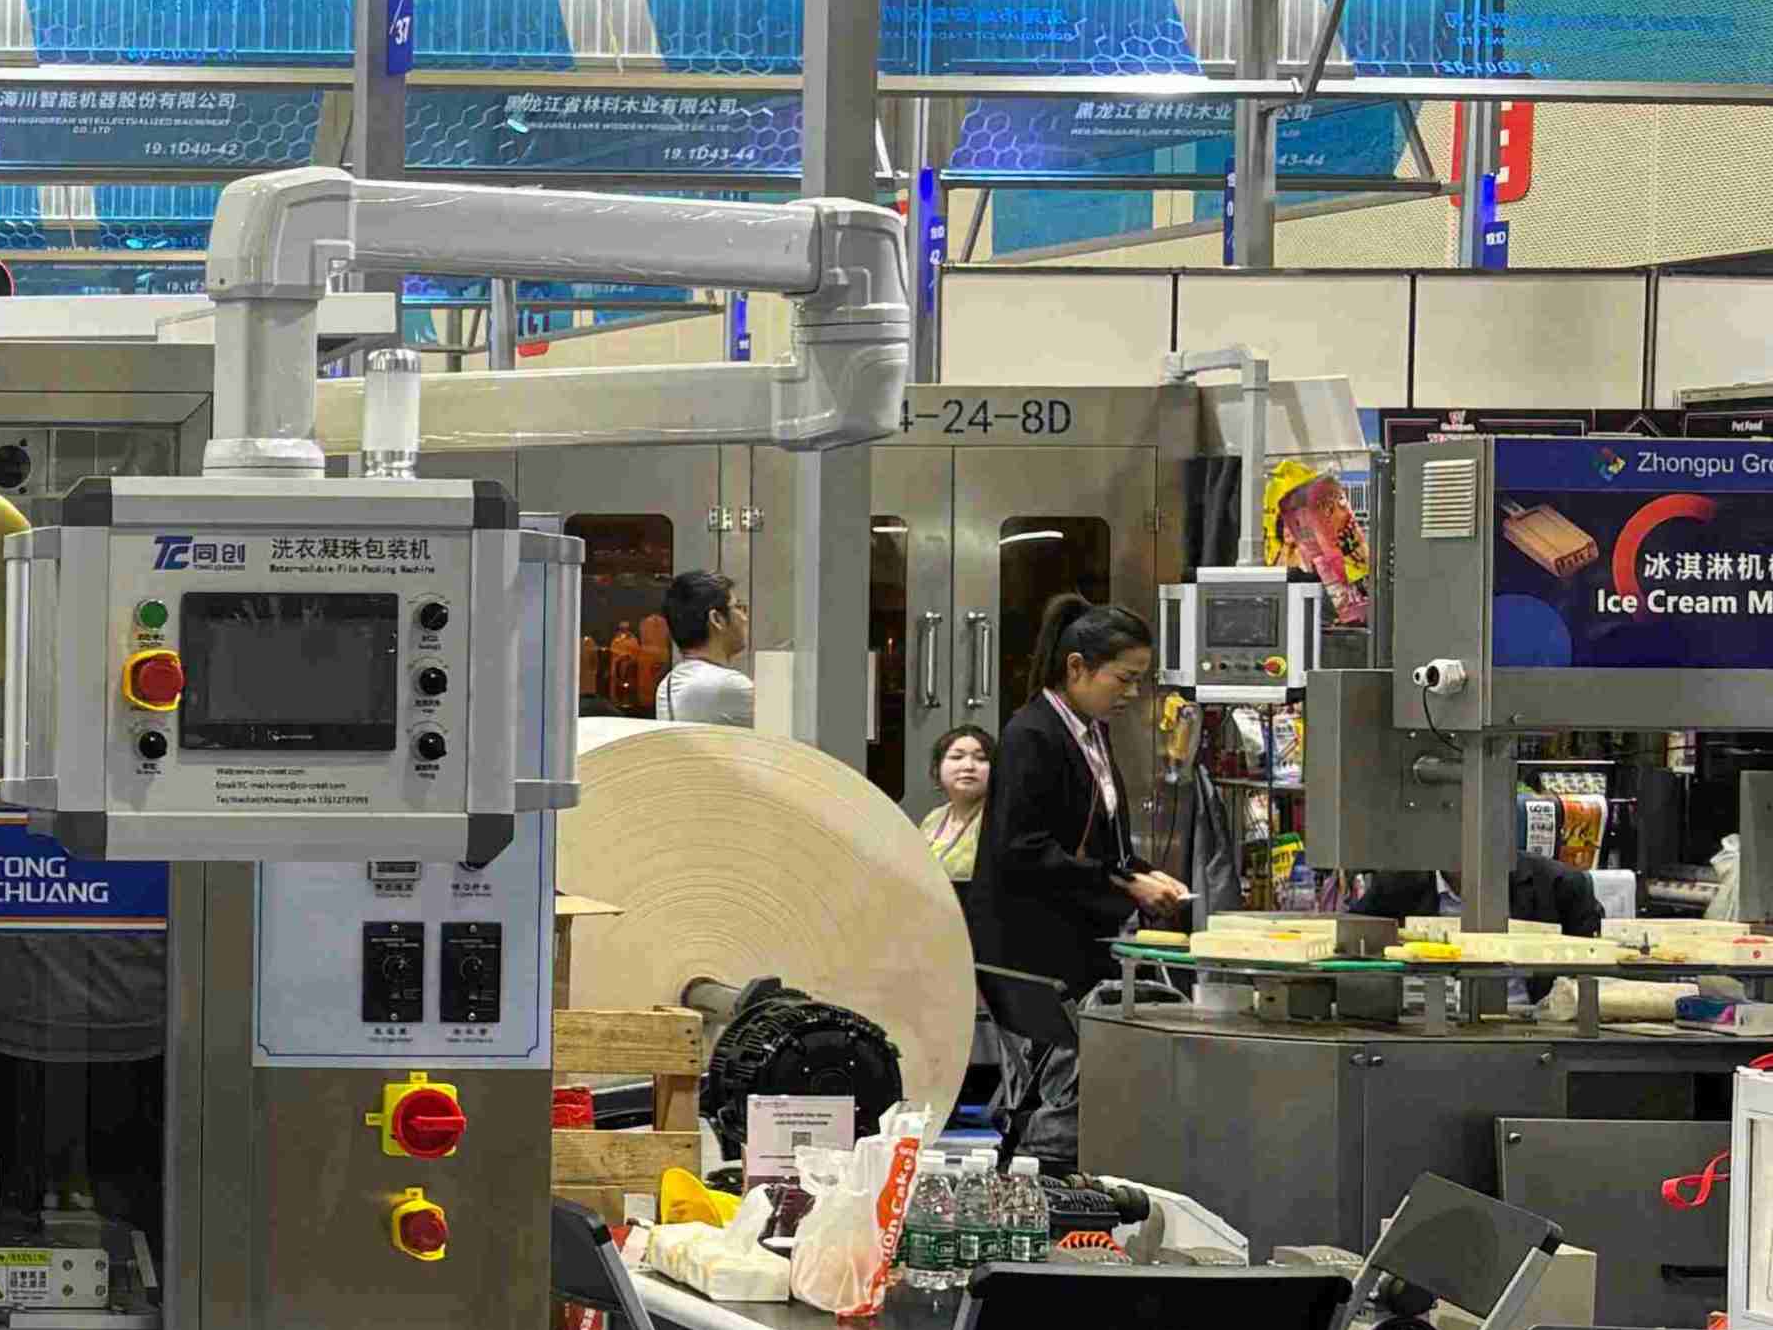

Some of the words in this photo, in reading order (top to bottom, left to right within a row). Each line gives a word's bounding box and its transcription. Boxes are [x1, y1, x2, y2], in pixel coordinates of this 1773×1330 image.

[394, 15, 411, 46] 37
[143, 141, 238, 157] 19.1D40-42
[662, 145, 755, 161] 19.1D43-44
[1636, 451, 1734, 478] Zhongpu
[193, 542, 246, 564] 同创
[271, 537, 431, 560] 洗衣凝珠包装机
[1643, 551, 1773, 582] 冰淇淋机
[1597, 588, 1639, 613] Ice
[1647, 589, 1738, 614] Cream
